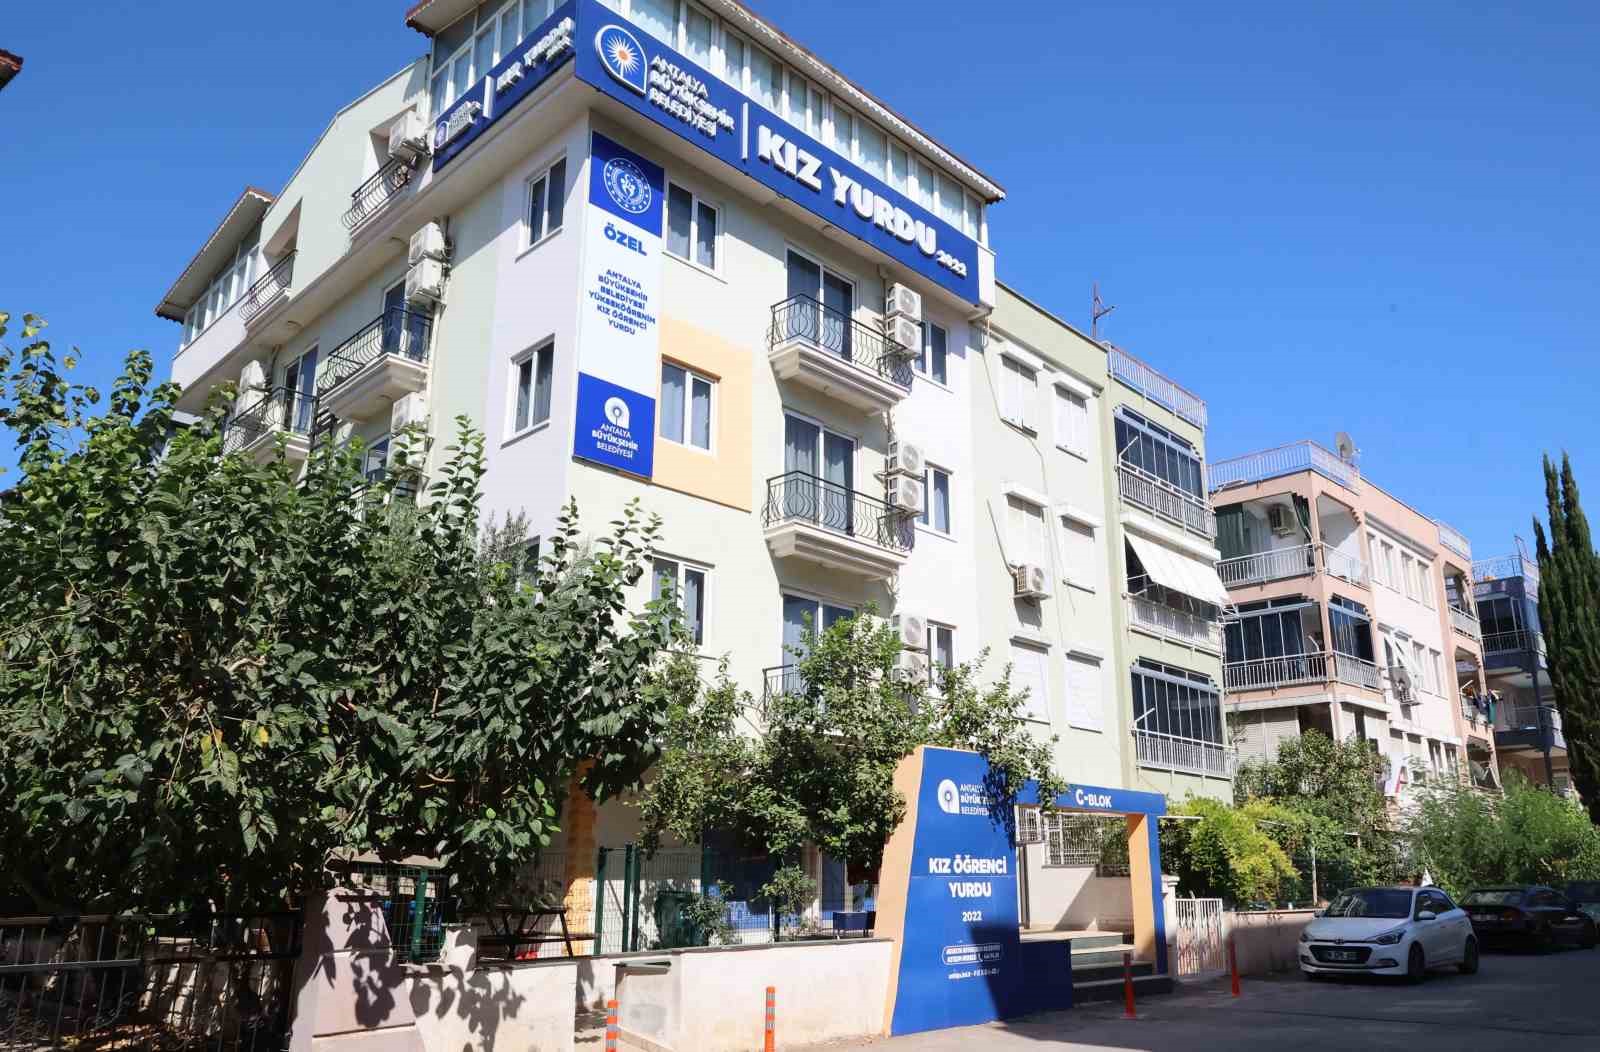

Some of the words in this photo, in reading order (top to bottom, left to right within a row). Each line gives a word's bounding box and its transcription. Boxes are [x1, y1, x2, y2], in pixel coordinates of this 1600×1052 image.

[651, 55, 708, 98] ANTALYA
[648, 87, 717, 137] BELEDİYESİ
[758, 125, 822, 191] KIZ
[830, 166, 937, 256] YURDU
[935, 250, 967, 278] 2022
[604, 222, 648, 257] ÖZEL
[606, 268, 642, 290] ANTALYA
[600, 285, 645, 311] BELEDİYESİ
[597, 303, 611, 316] KIZ
[611, 308, 647, 330] ÖĞRENCİ
[608, 318, 636, 336] YURDU
[601, 423, 631, 440] ANTALYA
[1075, 789, 1112, 808] C-BLOK
[929, 857, 952, 874] KIZ
[953, 854, 1007, 874] ÖĞRENCİ
[948, 882, 992, 898] YURDU
[962, 910, 982, 922] 2022
